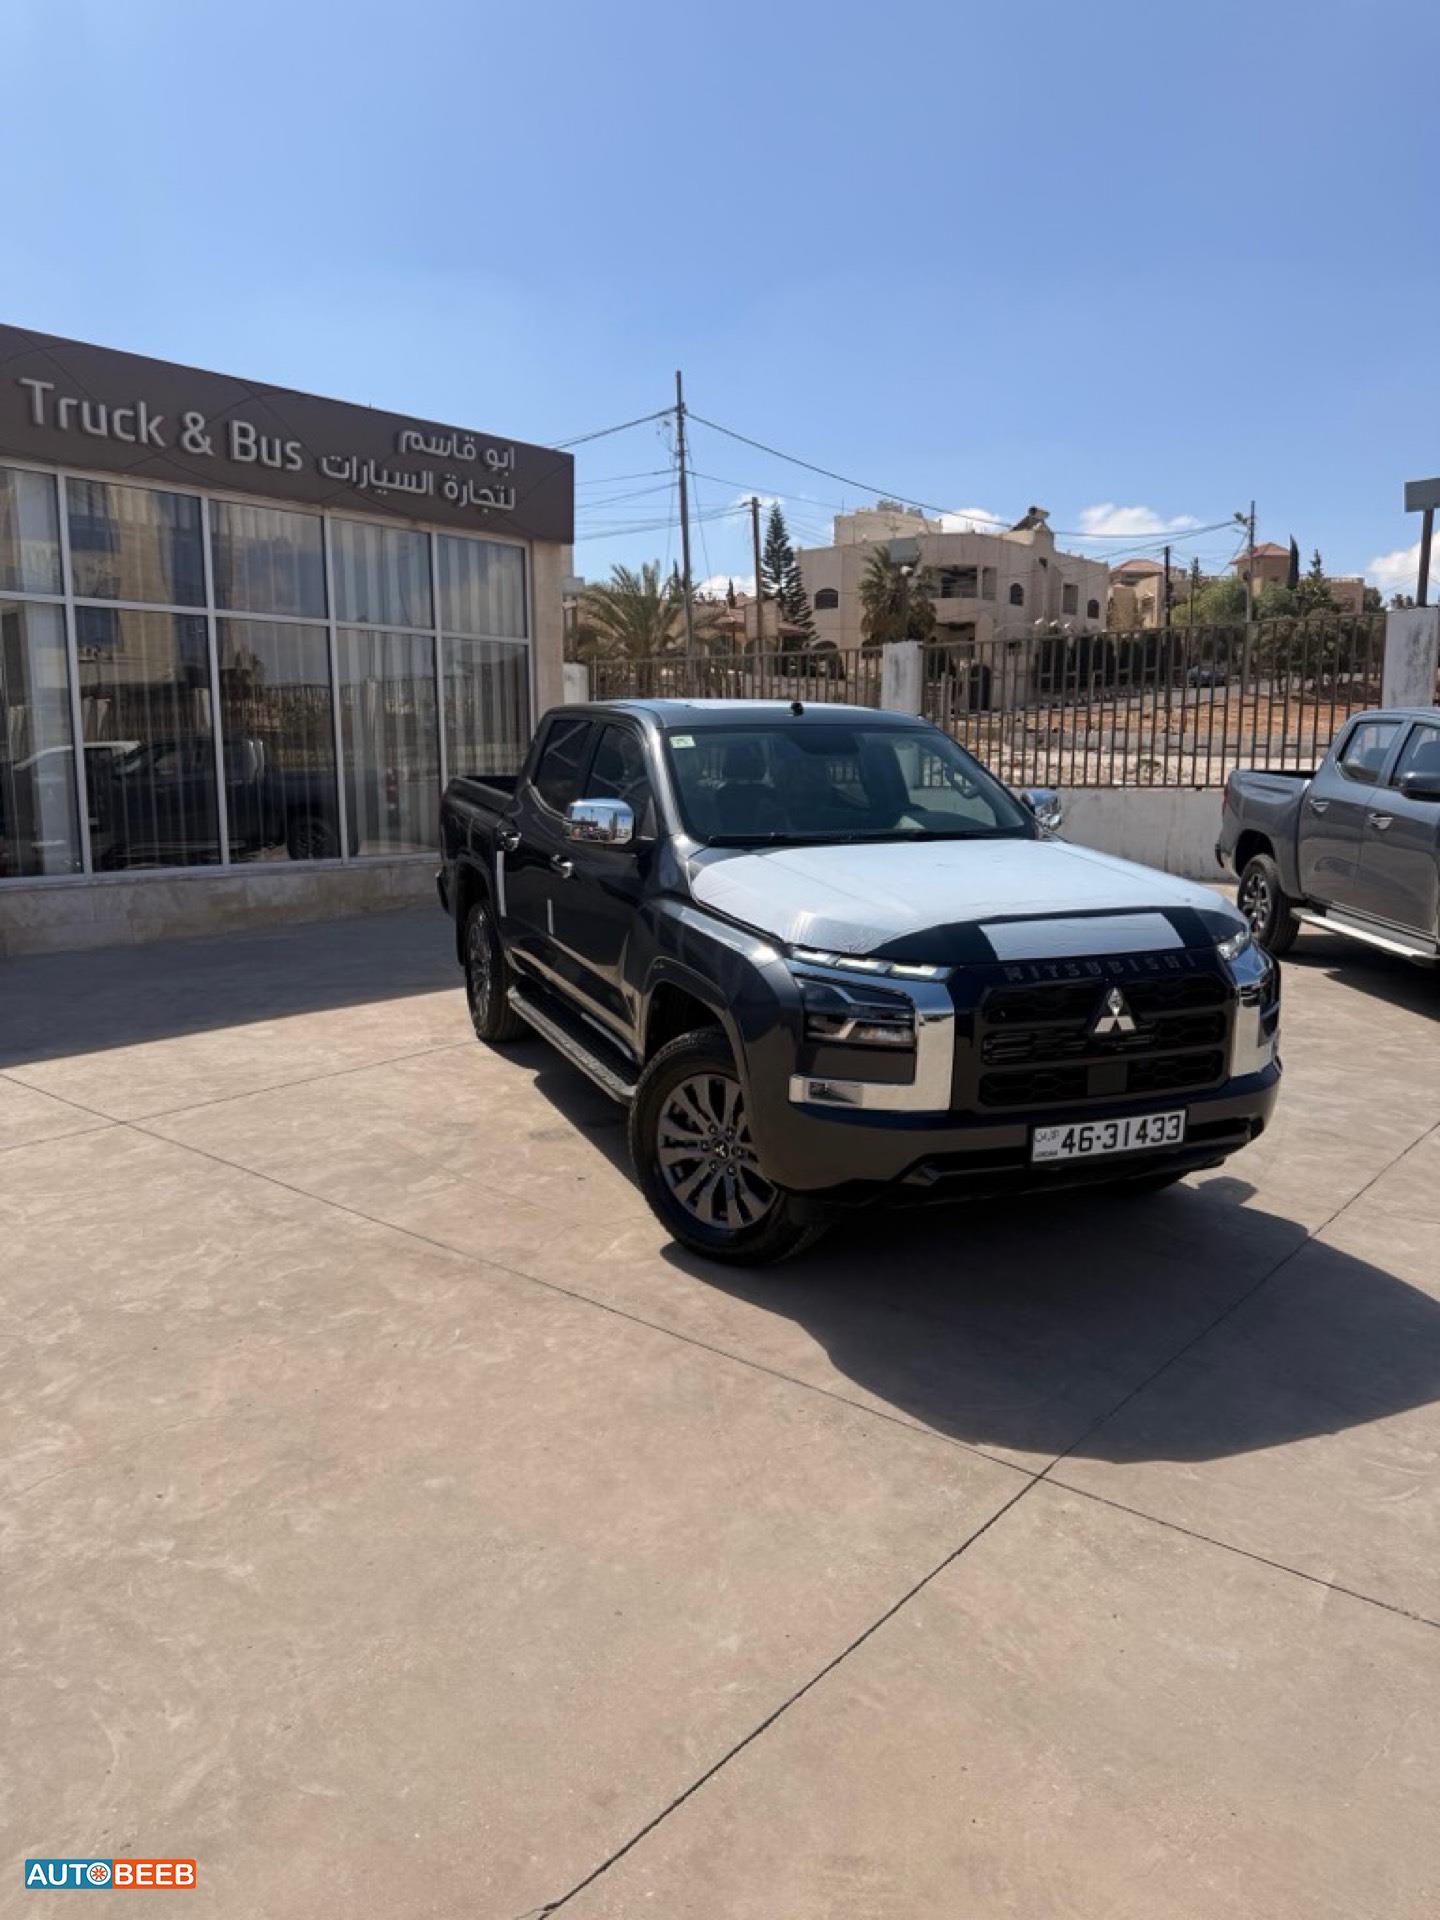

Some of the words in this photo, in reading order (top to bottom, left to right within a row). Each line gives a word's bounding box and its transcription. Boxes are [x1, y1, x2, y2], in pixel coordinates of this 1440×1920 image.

[19, 377, 166, 448] Truck
[181, 411, 215, 456] &
[229, 419, 303, 471] Bus
[401, 430, 476, 460] قاسم
[322, 455, 434, 495] السيارات
[444, 473, 515, 513] لتجارة
[1003, 953, 1196, 982] MITSUBISHI
